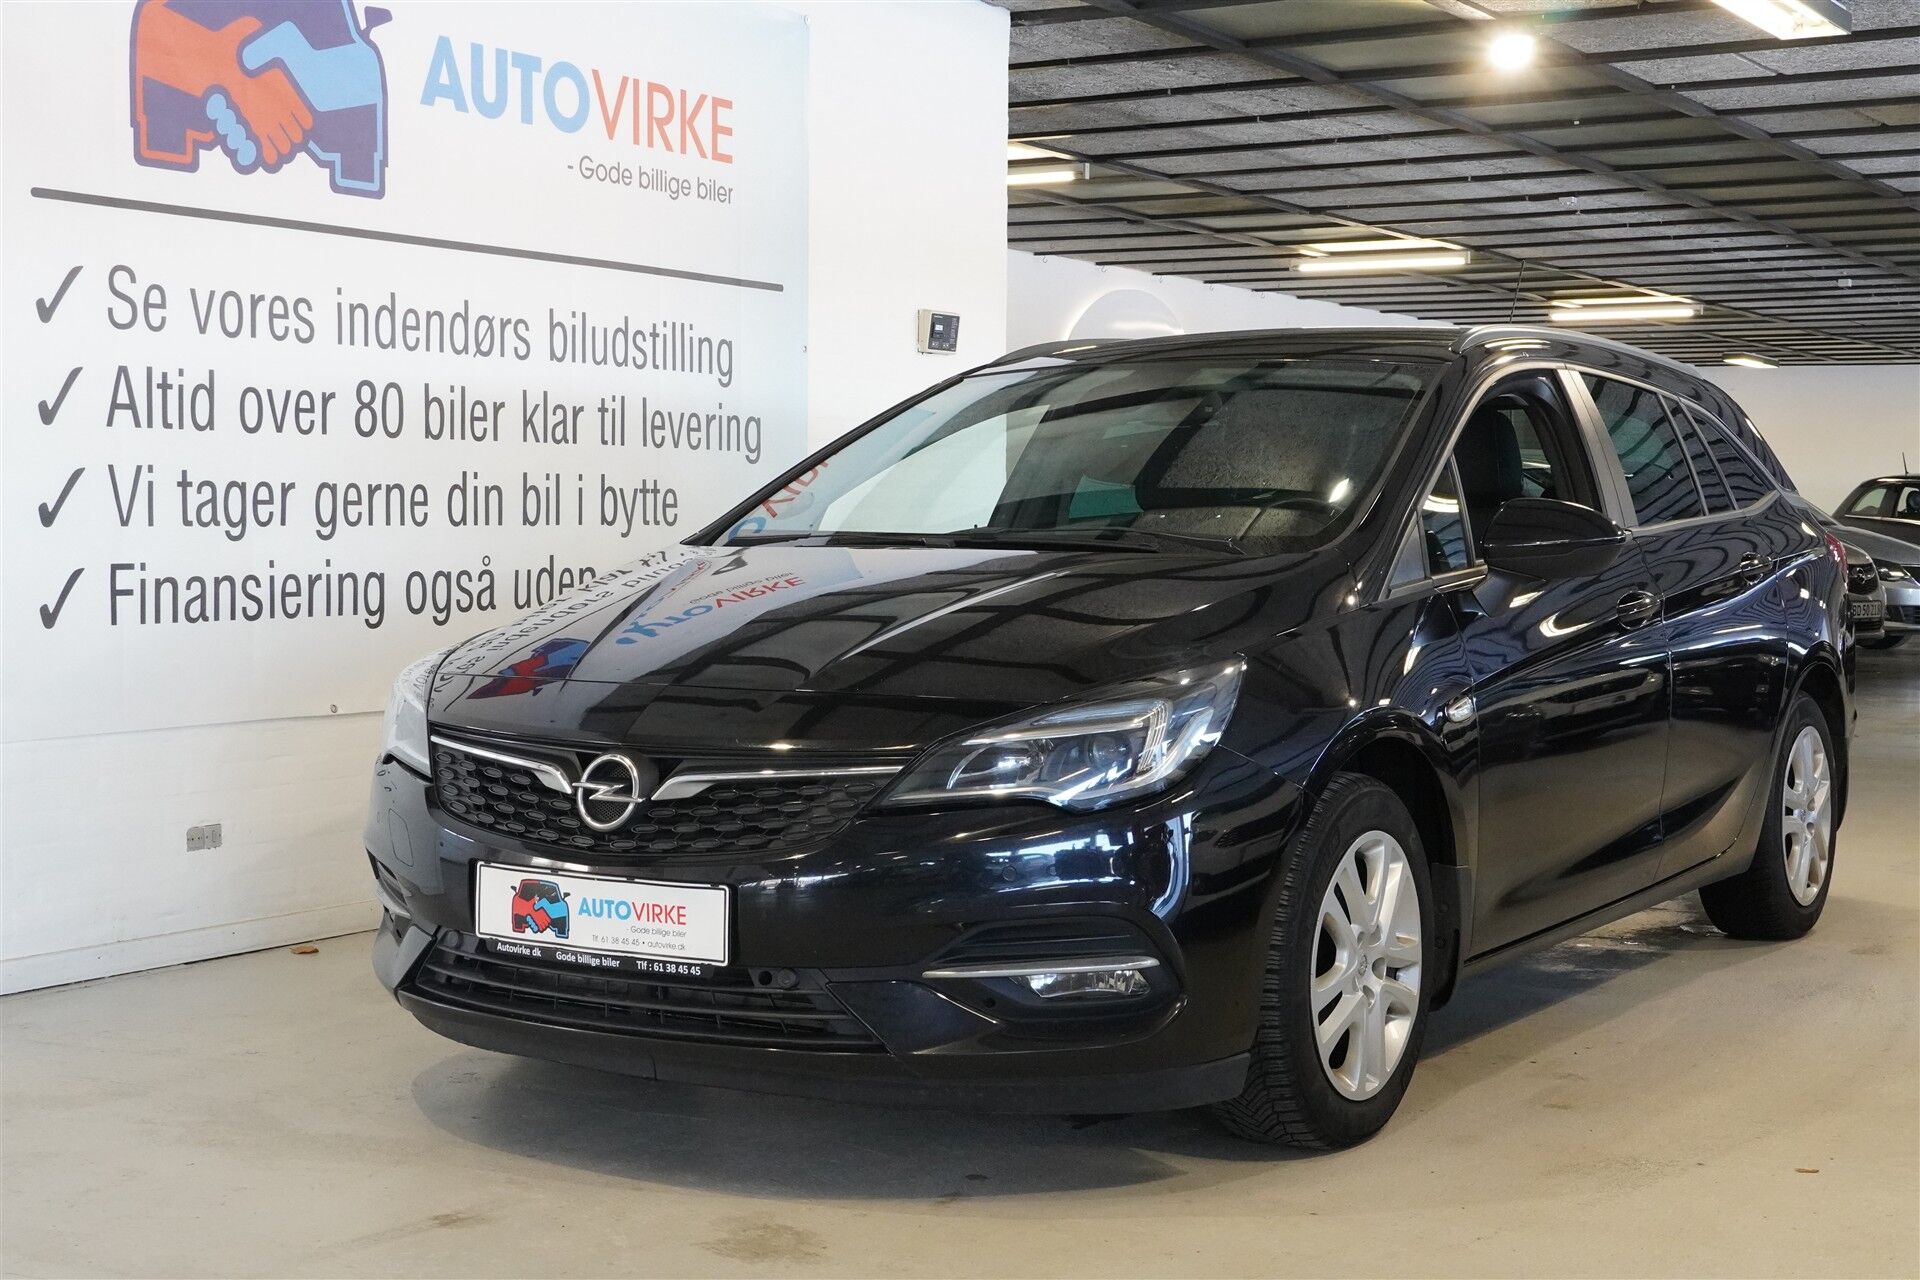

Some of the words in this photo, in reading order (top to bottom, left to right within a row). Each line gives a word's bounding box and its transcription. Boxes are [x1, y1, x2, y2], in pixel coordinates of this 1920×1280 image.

[421, 36, 733, 164] AUTOVIRKE
[579, 156, 633, 189] Gode
[639, 164, 692, 201] billige
[696, 177, 734, 204] biler
[108, 265, 167, 331] Se
[190, 288, 315, 344] vores
[336, 287, 530, 362] indendørs
[549, 308, 733, 388] biludstilling
[106, 365, 215, 433] Altid
[239, 386, 336, 437] over
[354, 379, 405, 440] 80
[424, 382, 506, 443] biler
[522, 389, 584, 446] klar
[598, 396, 626, 448] til
[642, 397, 762, 465] levering
[107, 464, 154, 528] Vi
[176, 470, 296, 541] tager
[314, 481, 429, 541] gerne
[447, 470, 505, 528] din
[522, 472, 561, 527] bil
[577, 475, 584, 527] i
[600, 474, 679, 539] bytte
[109, 559, 386, 630] Finansiering
[405, 555, 497, 628] også
[513, 555, 597, 611] uden
[578, 897, 687, 925] AUTOVIRKE
[600, 935, 609, 943] 61
[611, 936, 619, 945] 38
[621, 937, 630, 946] 45
[631, 938, 640, 947] 45
[630, 925, 650, 935] Gode
[652, 927, 670, 938] billige
[672, 929, 687, 938] biler
[497, 942, 531, 956] Autovirke
[532, 947, 542, 957] dk
[556, 951, 576, 961] Gode
[601, 956, 620, 968] biler
[653, 962, 664, 972] 61
[665, 963, 677, 973] 38
[677, 964, 689, 975] 45
[690, 965, 701, 976] 45
